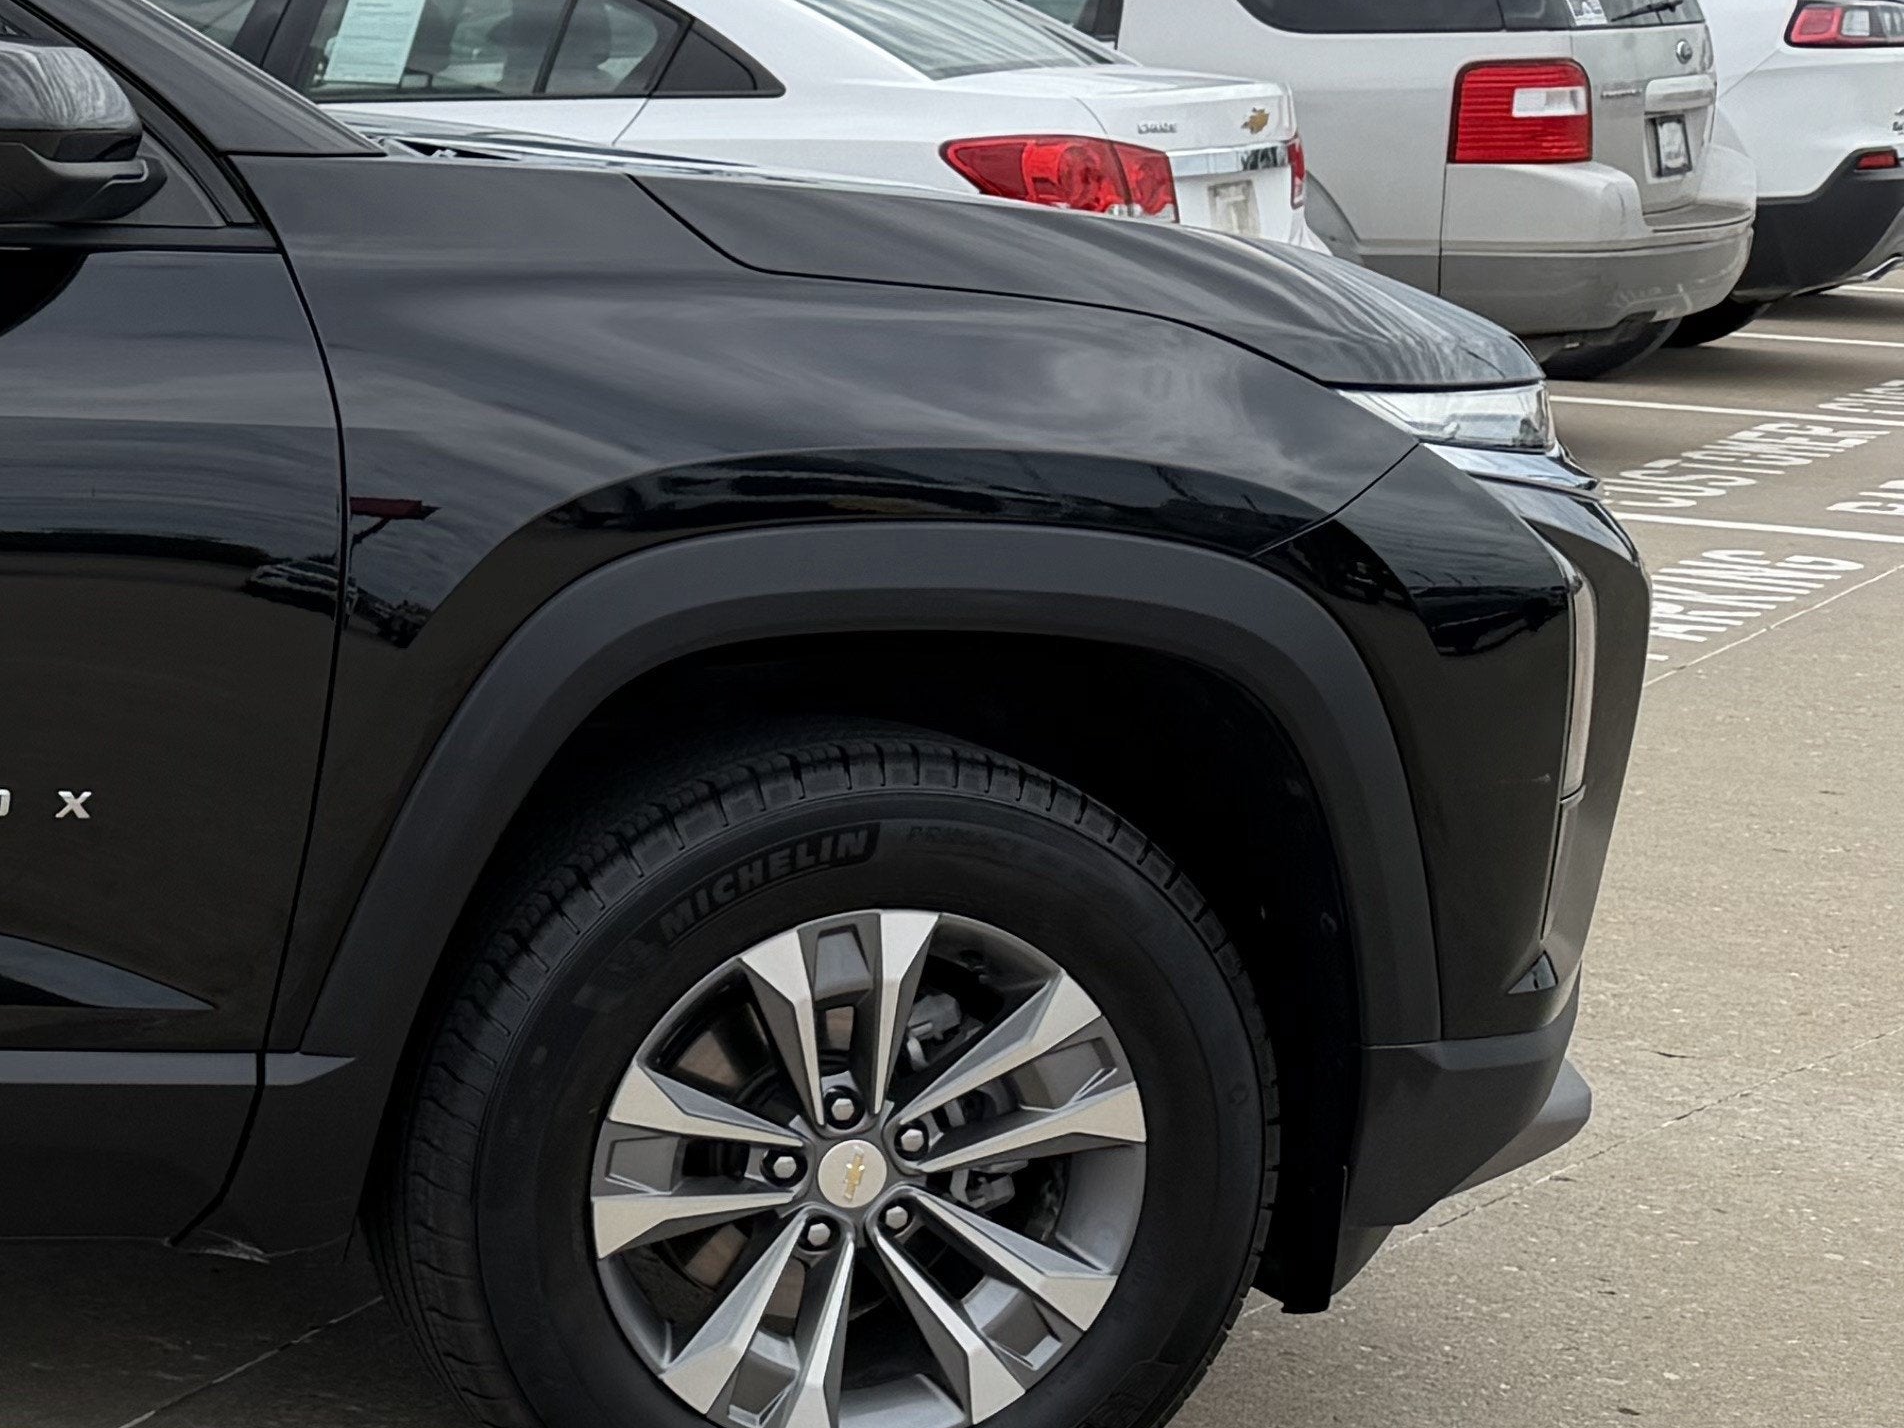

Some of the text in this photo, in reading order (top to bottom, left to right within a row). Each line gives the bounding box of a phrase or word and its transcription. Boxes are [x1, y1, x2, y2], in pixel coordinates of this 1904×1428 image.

[1597, 422, 1891, 509] CUSTOMER
[1649, 548, 1865, 663] RKING
[659, 828, 869, 940] MICHELIN
